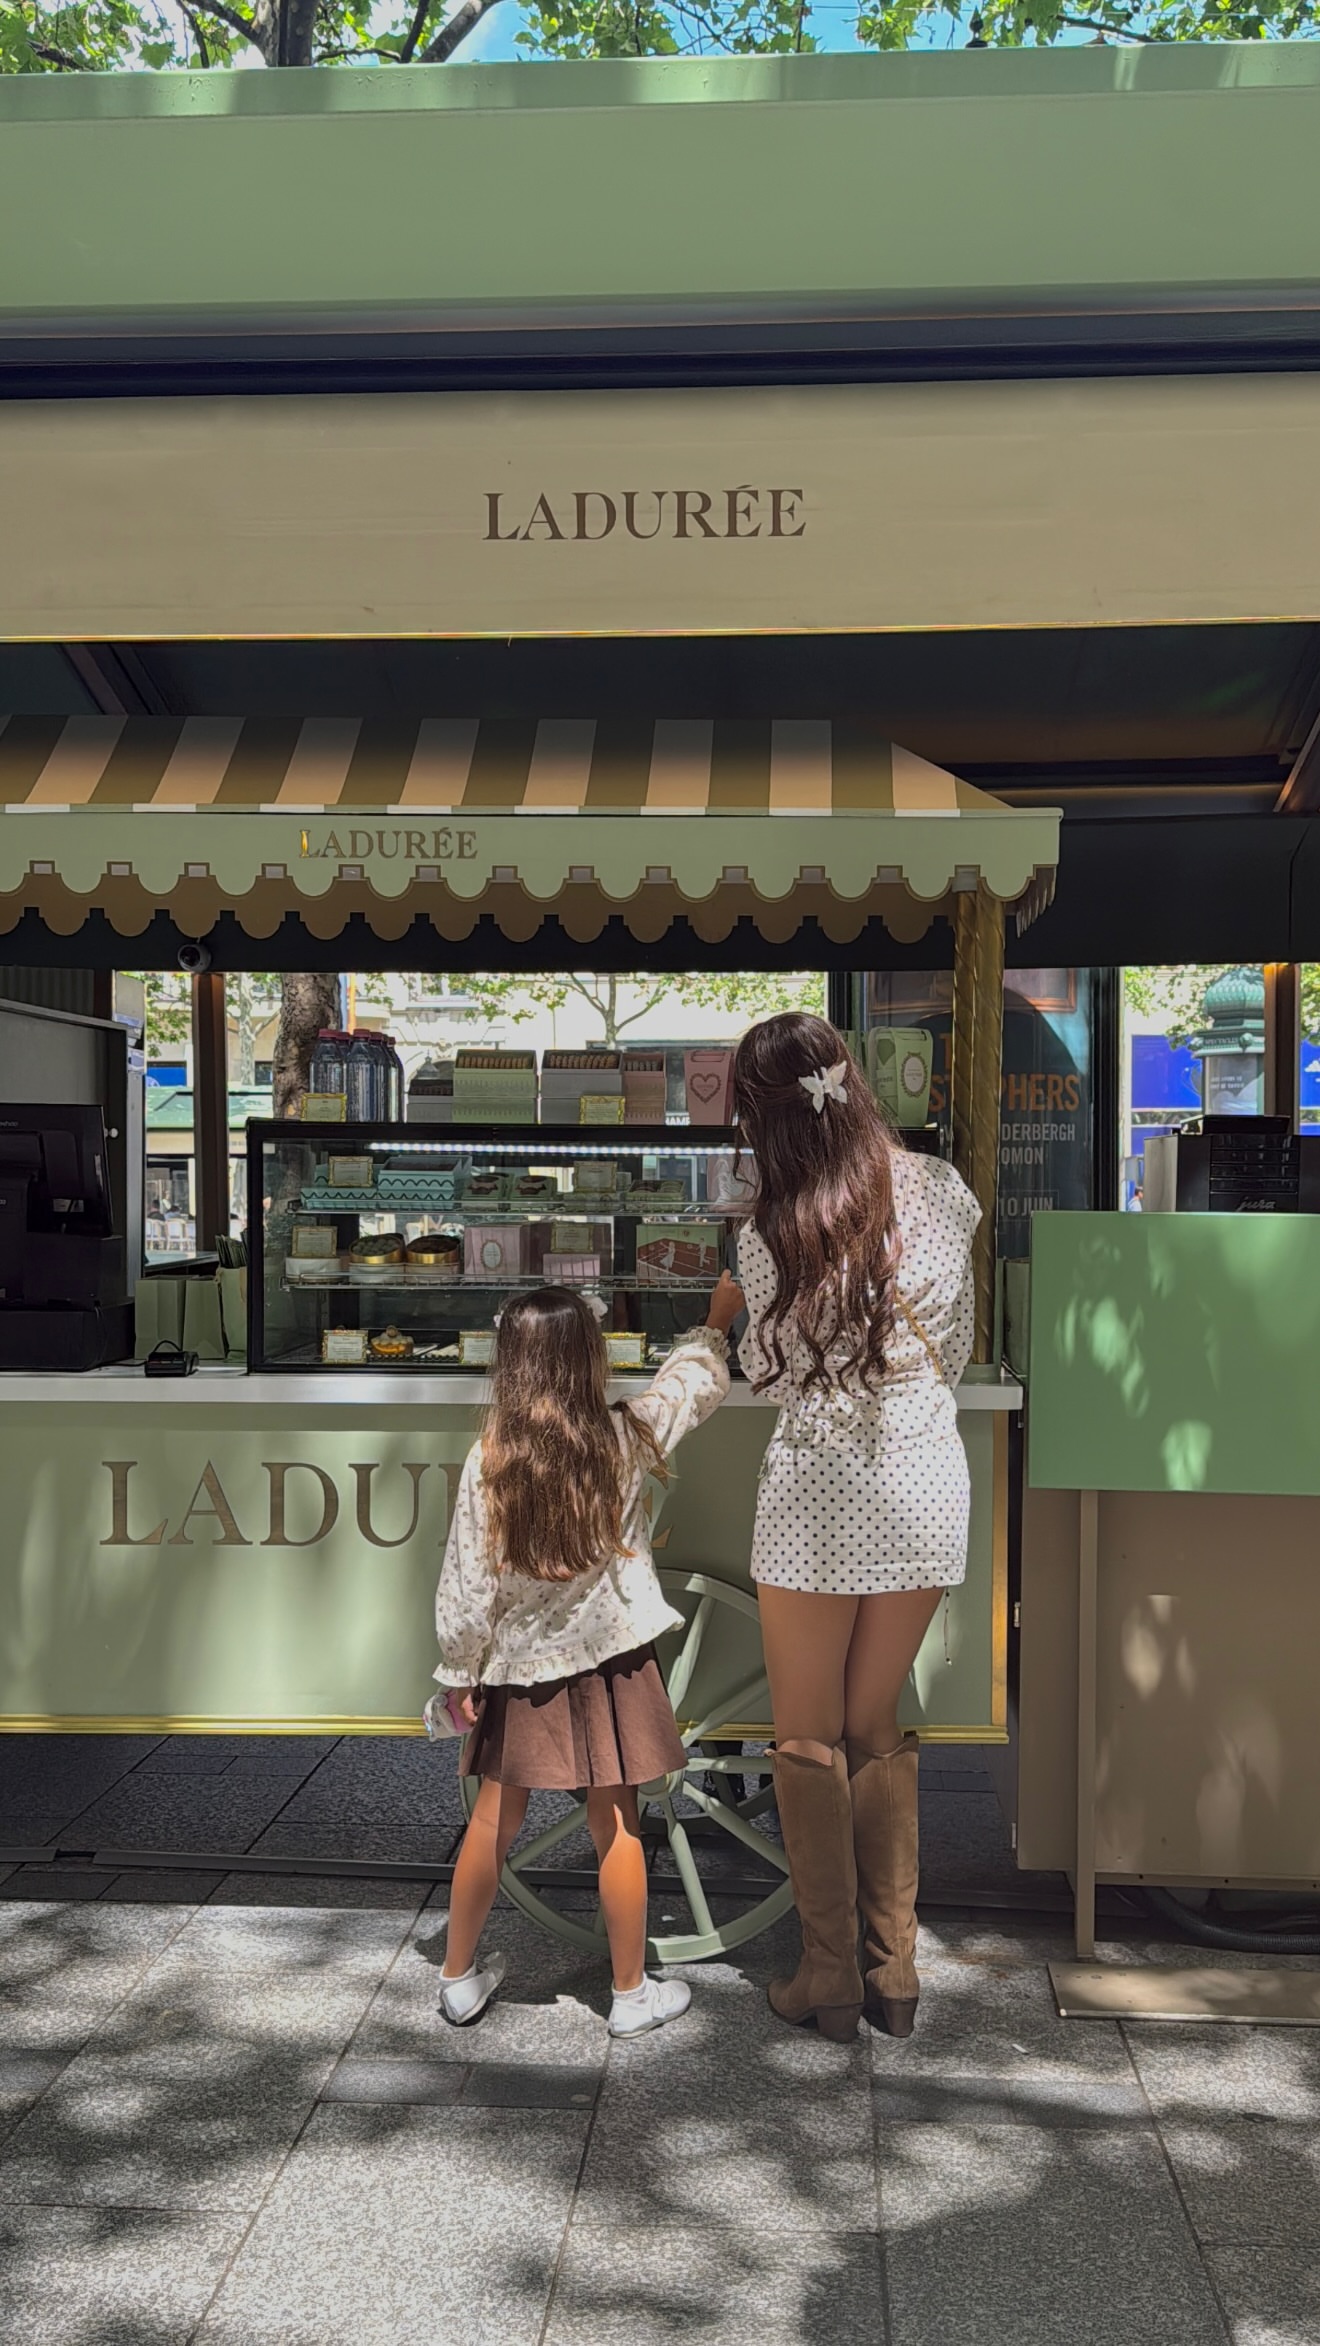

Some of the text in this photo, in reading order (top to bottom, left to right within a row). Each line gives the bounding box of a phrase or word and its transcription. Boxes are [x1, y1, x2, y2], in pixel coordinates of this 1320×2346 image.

[481, 483, 807, 541] LADURÉE
[300, 826, 479, 860] LADURÉE
[1001, 1123, 1076, 1141] DERBERGH
[999, 1147, 1044, 1165] OMON
[100, 1459, 673, 1548] LADU
